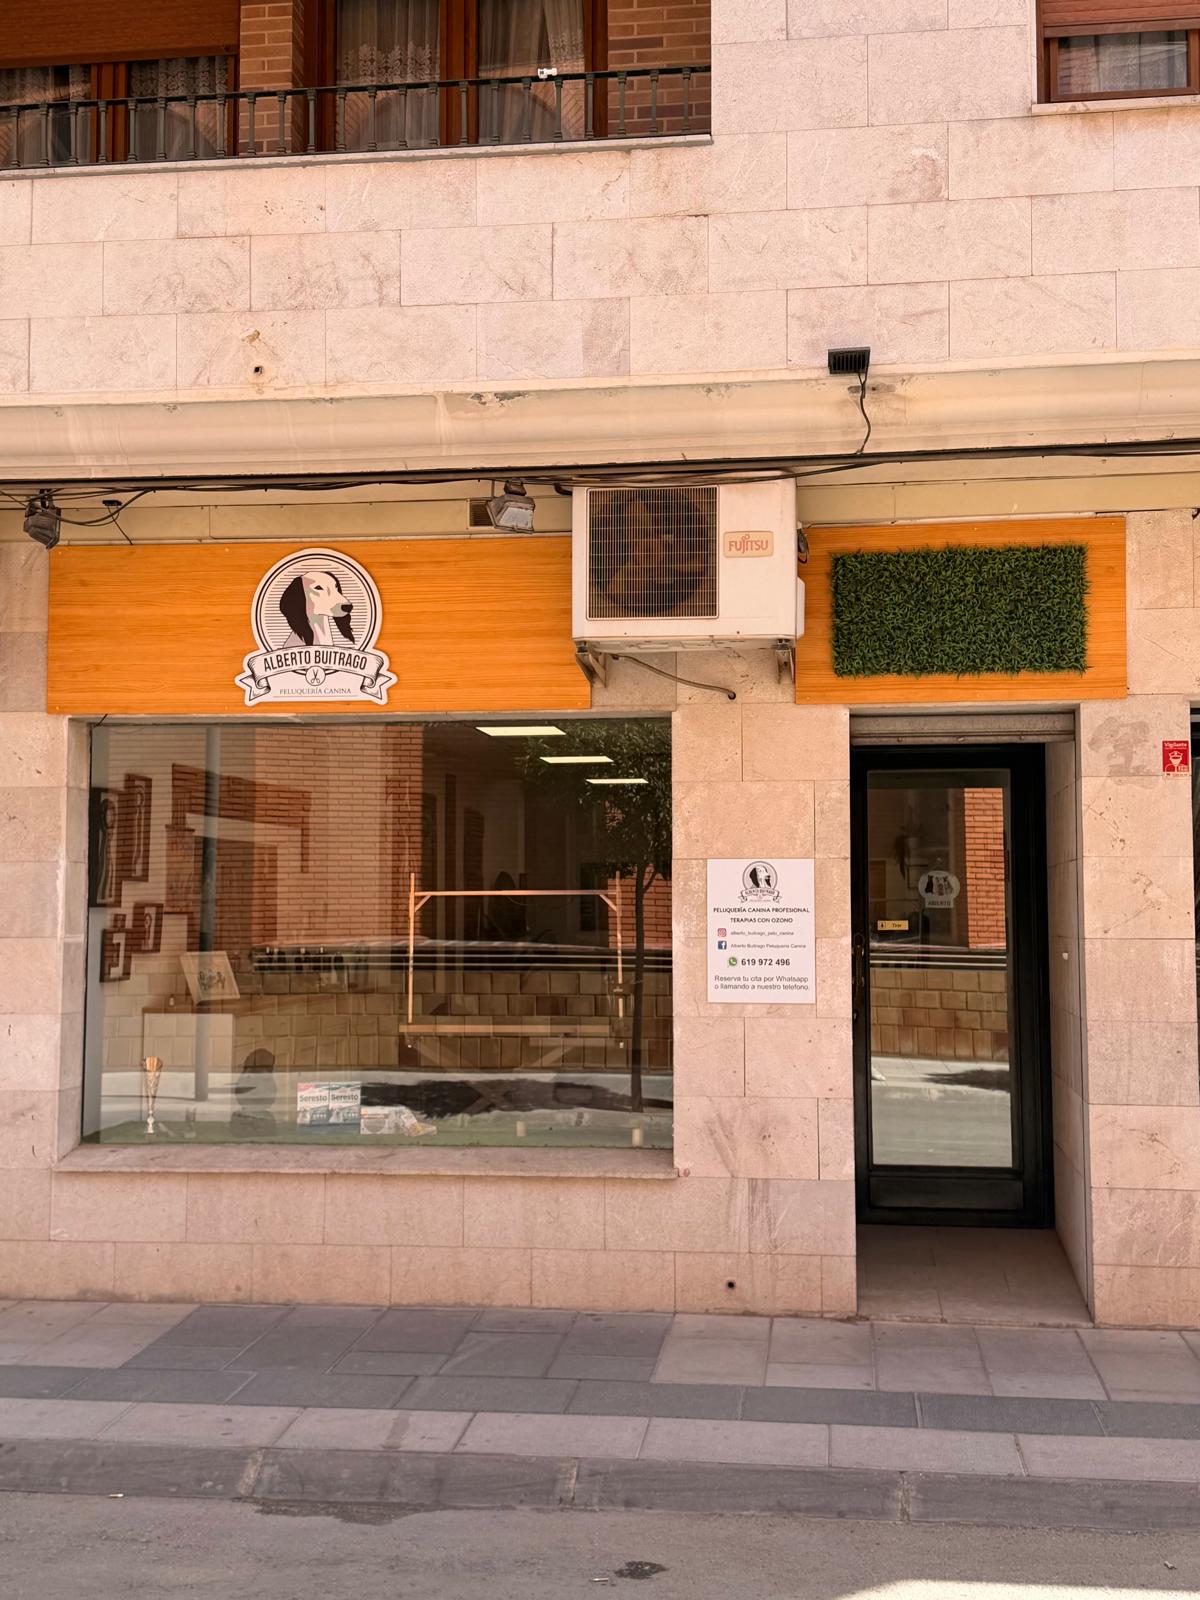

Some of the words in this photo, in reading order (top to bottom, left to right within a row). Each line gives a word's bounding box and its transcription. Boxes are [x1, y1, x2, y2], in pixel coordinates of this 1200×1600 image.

[728, 534, 769, 554] FUJITSU
[263, 650, 311, 673] ALBERTO
[314, 651, 368, 671] BUITRAGO
[279, 686, 322, 696] PELUQUERÍA
[323, 687, 352, 695] CANINA
[299, 1094, 328, 1102] Seresto
[331, 1093, 359, 1102] Seresto
